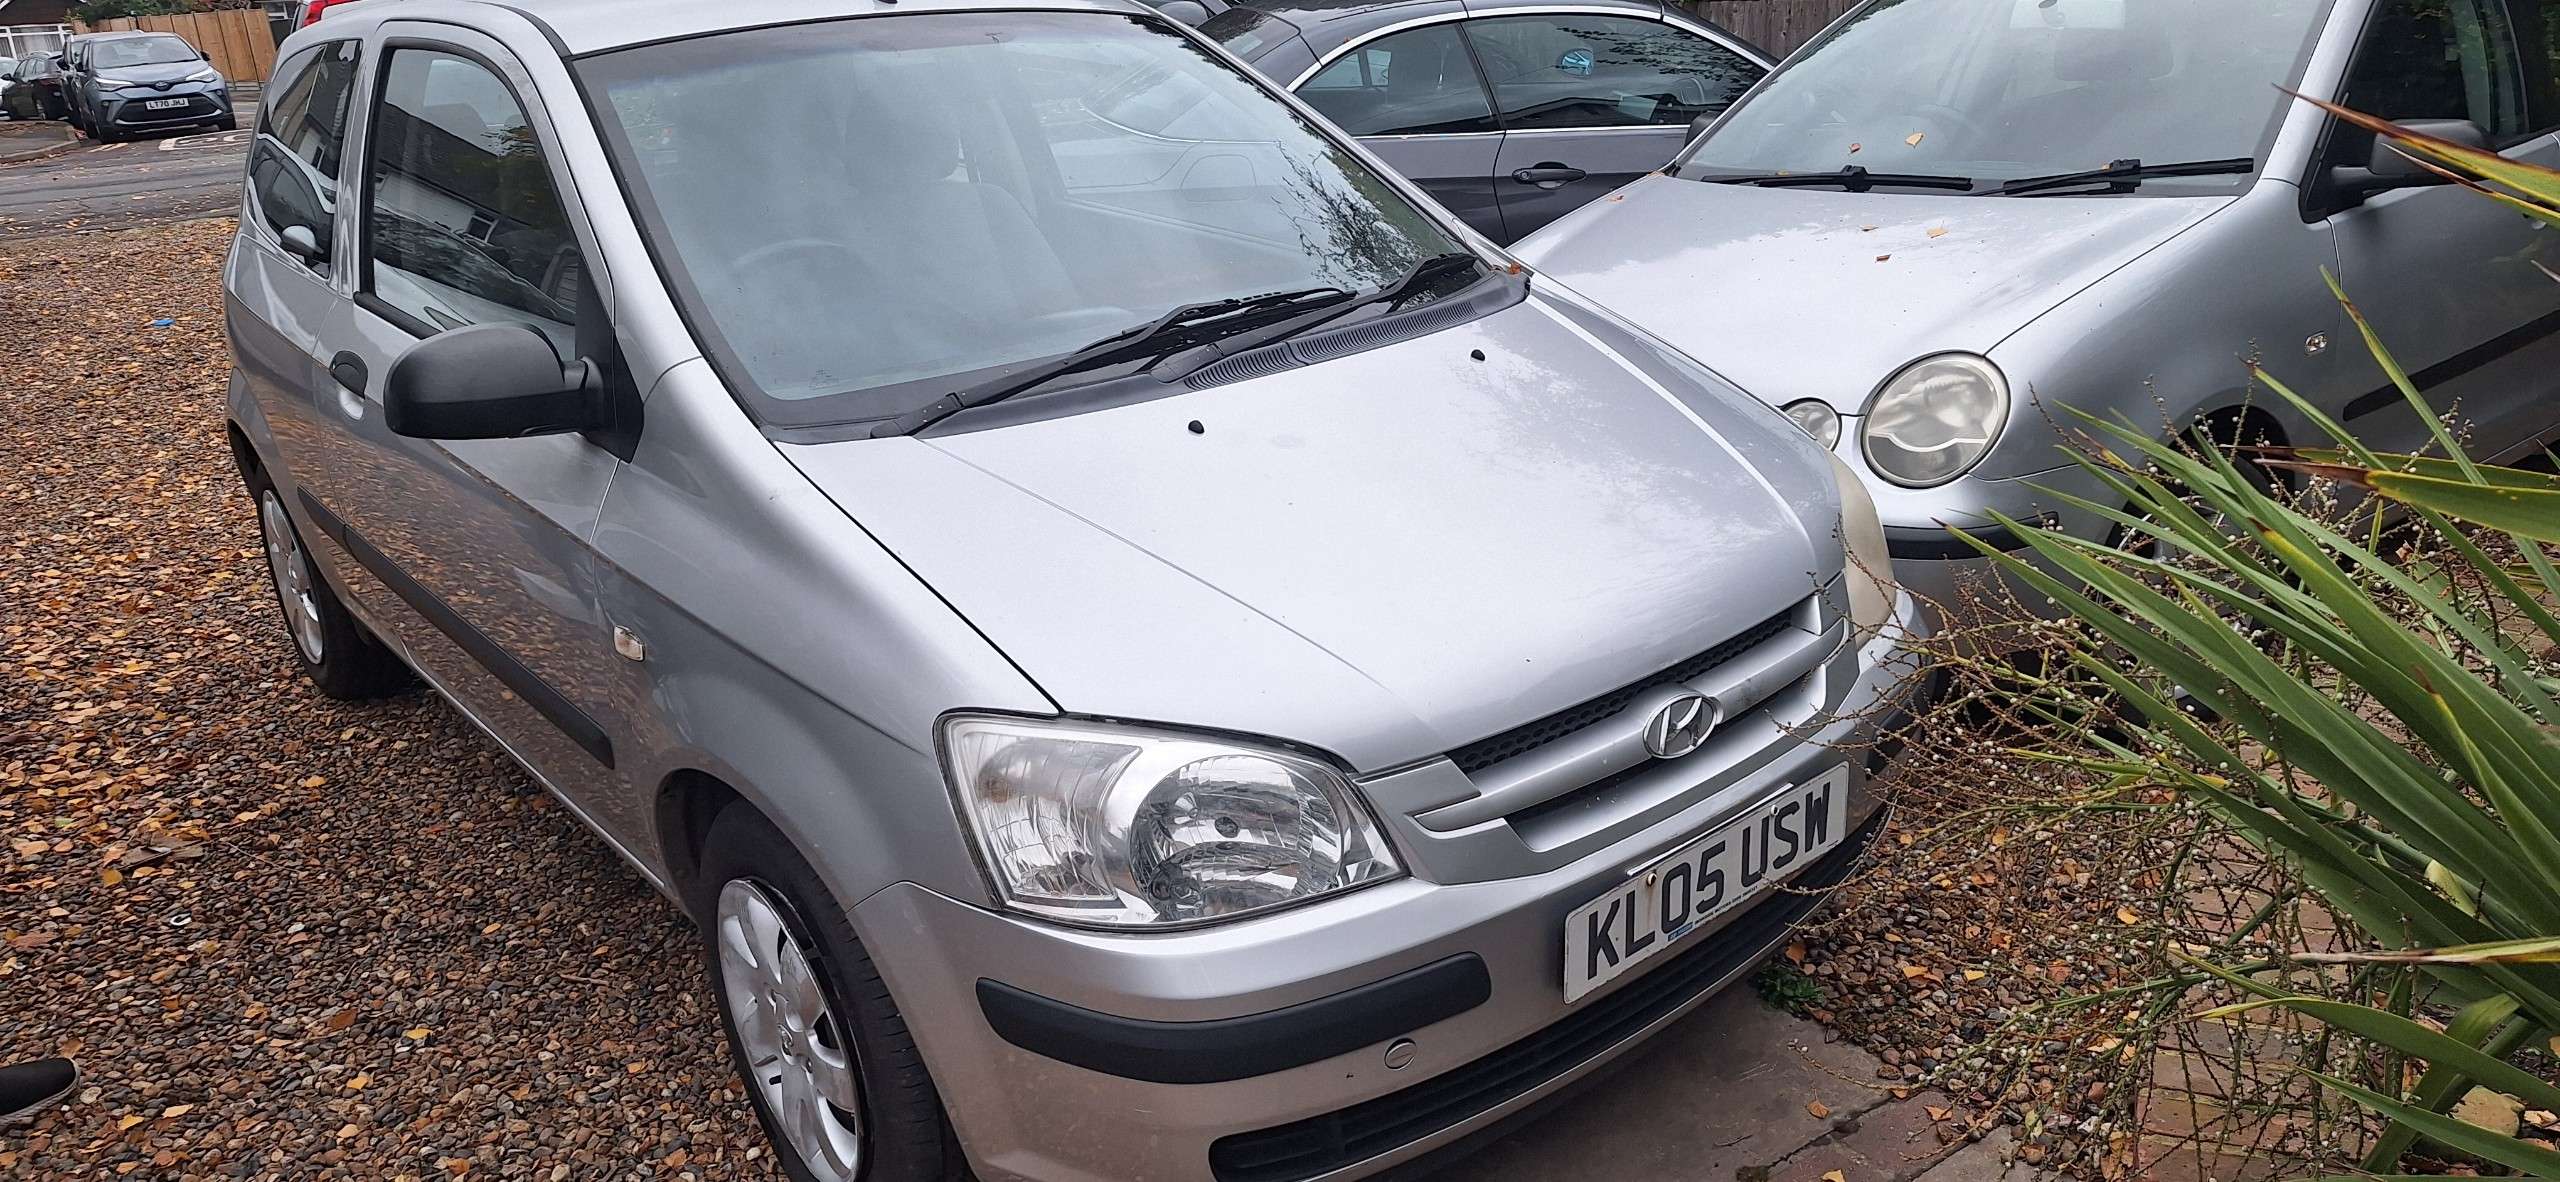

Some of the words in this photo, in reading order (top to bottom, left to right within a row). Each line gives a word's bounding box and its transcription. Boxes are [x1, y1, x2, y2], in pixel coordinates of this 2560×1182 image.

[149, 101, 170, 109] LT70
[1587, 840, 1726, 981] KL05
[1740, 781, 1831, 888] USW
